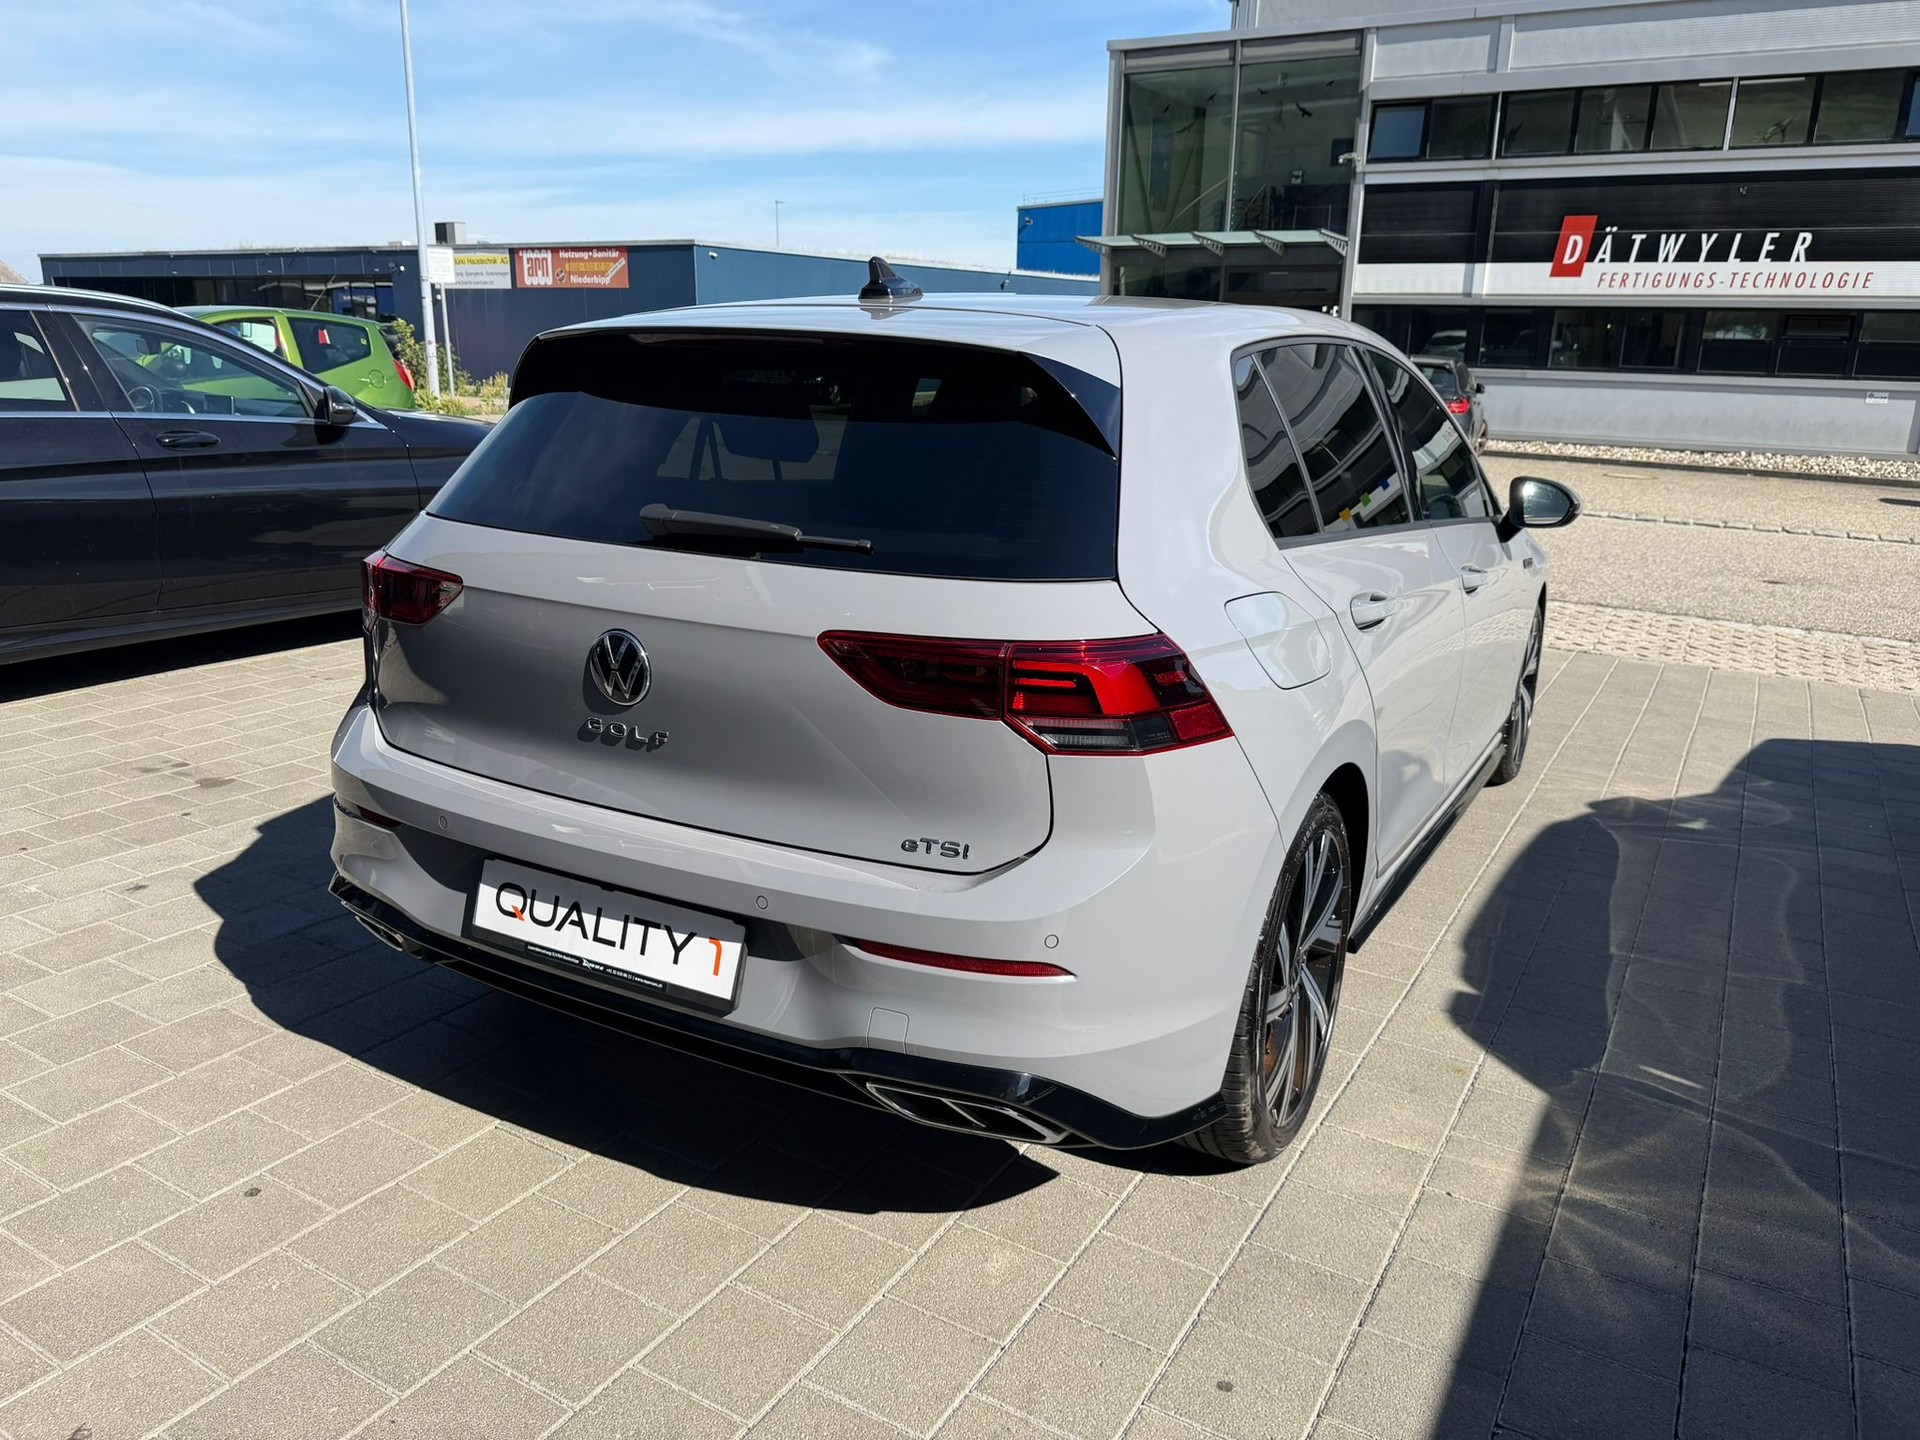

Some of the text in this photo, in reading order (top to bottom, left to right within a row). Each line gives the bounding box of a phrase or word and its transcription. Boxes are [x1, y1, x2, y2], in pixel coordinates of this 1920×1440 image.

[1562, 226, 1813, 265] DÄTWYLER
[500, 256, 509, 265] AG
[570, 274, 611, 285] Niederbipp
[1597, 271, 1874, 289] FERTIGUNGS-TECHNOLOGIE
[587, 716, 670, 746] GOLF
[495, 881, 698, 966] QUALITY
